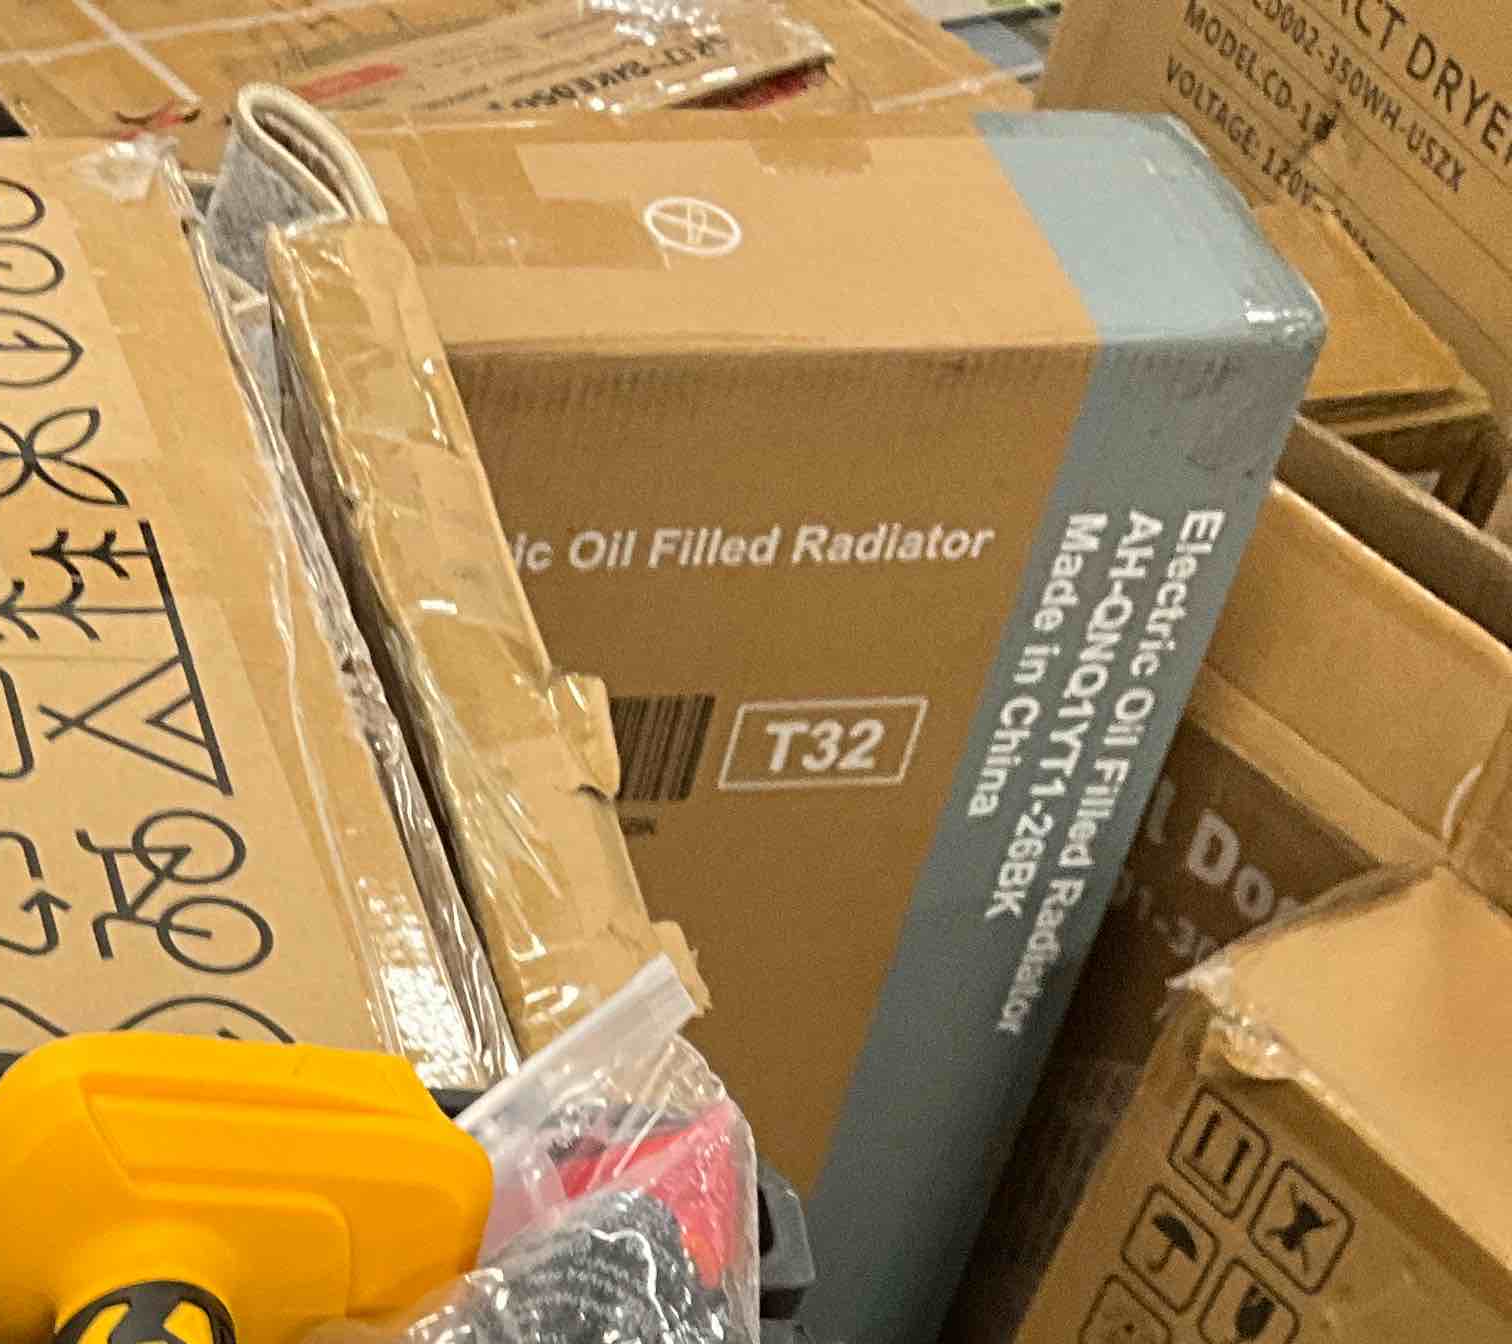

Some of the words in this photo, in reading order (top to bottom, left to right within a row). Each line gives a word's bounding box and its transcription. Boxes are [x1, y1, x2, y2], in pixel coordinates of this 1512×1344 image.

[1406, 32, 1512, 166] DRYE
[569, 529, 637, 570] Oil
[647, 526, 778, 569] Filled
[789, 523, 994, 564] Radiator
[1032, 510, 1108, 634] Made
[1130, 508, 1223, 679] Electric
[1013, 645, 1062, 685] in
[1100, 690, 1156, 750] Oil
[762, 718, 888, 775] T32
[967, 695, 1041, 819] China
[1058, 756, 1129, 869] Filled
[996, 880, 1085, 1034] Radiator
